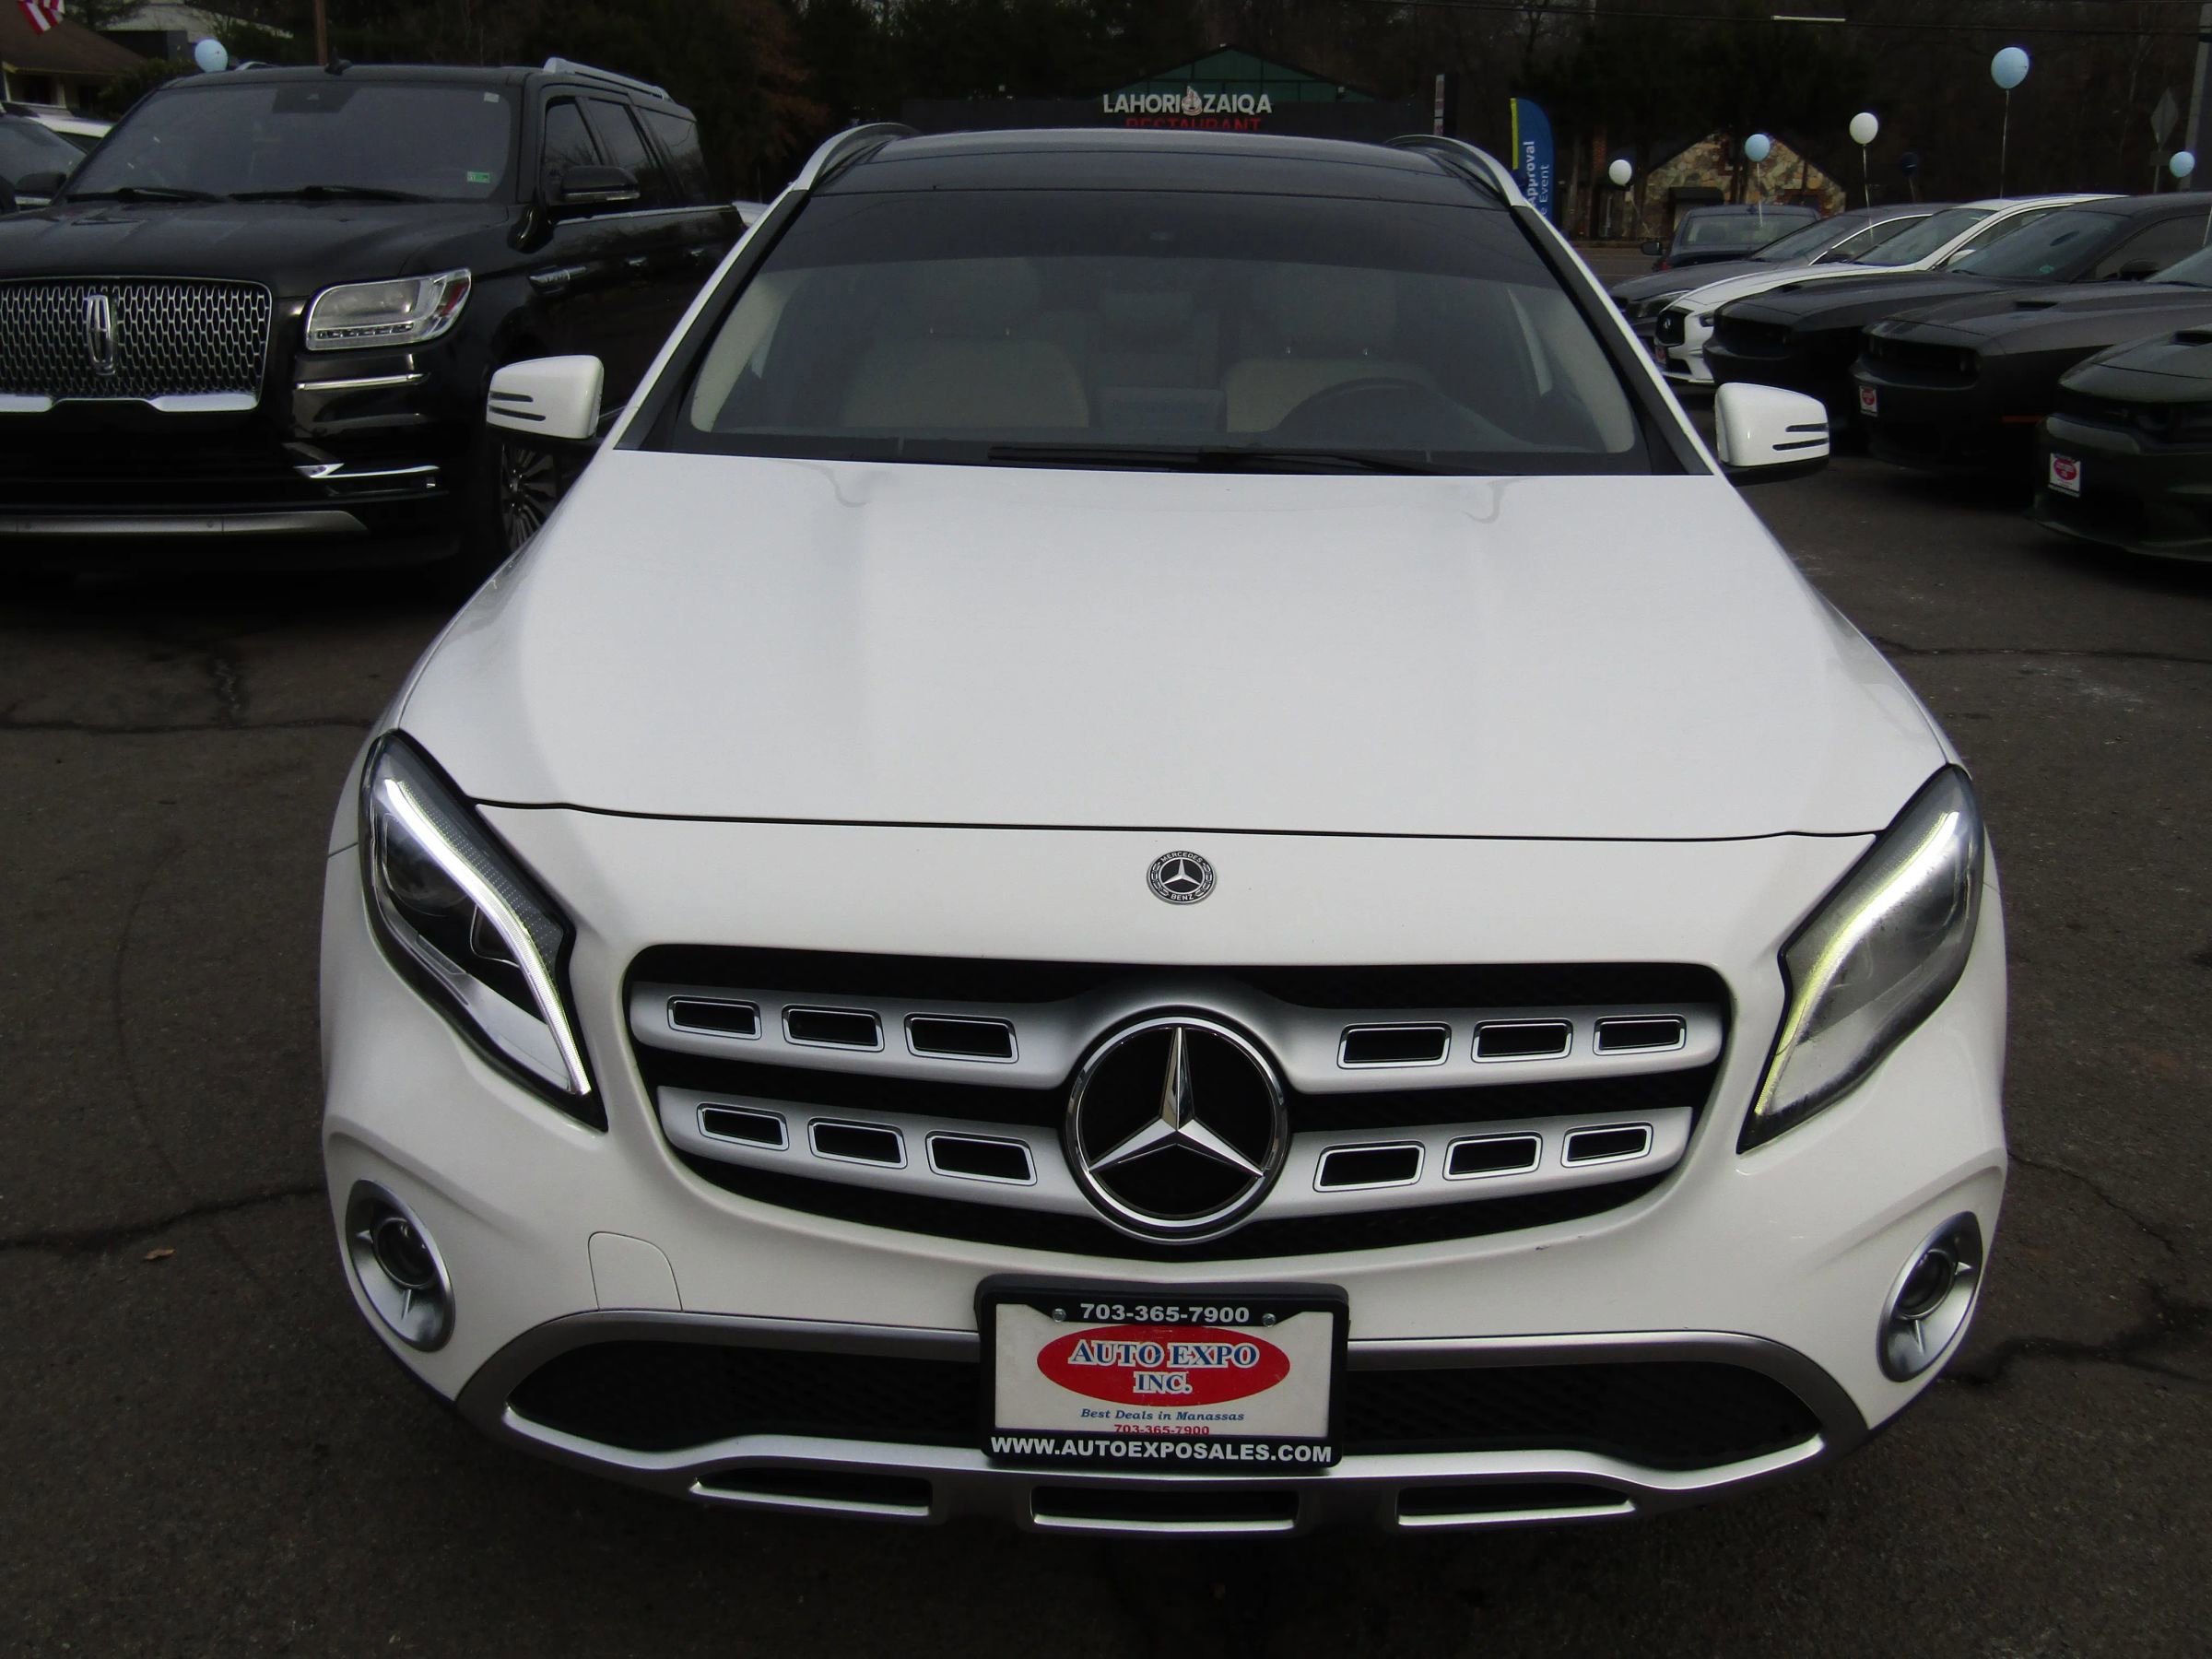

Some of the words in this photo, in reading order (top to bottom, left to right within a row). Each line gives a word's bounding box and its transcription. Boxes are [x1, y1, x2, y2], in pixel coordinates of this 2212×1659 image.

[1103, 94, 1180, 112] LAHORI
[1204, 94, 1272, 115] ZAIQA
[1523, 141, 1539, 207] Approval
[1539, 163, 1549, 203] Event
[1160, 852, 1203, 863] MERCEDES
[1080, 1303, 1250, 1323] 703-365-7900
[1069, 1339, 1164, 1367] AUTO
[1167, 1342, 1260, 1368] EXPO
[1133, 1371, 1193, 1394] INC.
[1081, 1408, 1111, 1418] Best
[1115, 1410, 1153, 1420] Deals
[1158, 1411, 1171, 1420] in
[1175, 1411, 1245, 1421] Manassas
[1113, 1424, 1209, 1435] 703-365-7900
[991, 1437, 1331, 1462] WWW.AUTOEXPOSALES.COM
